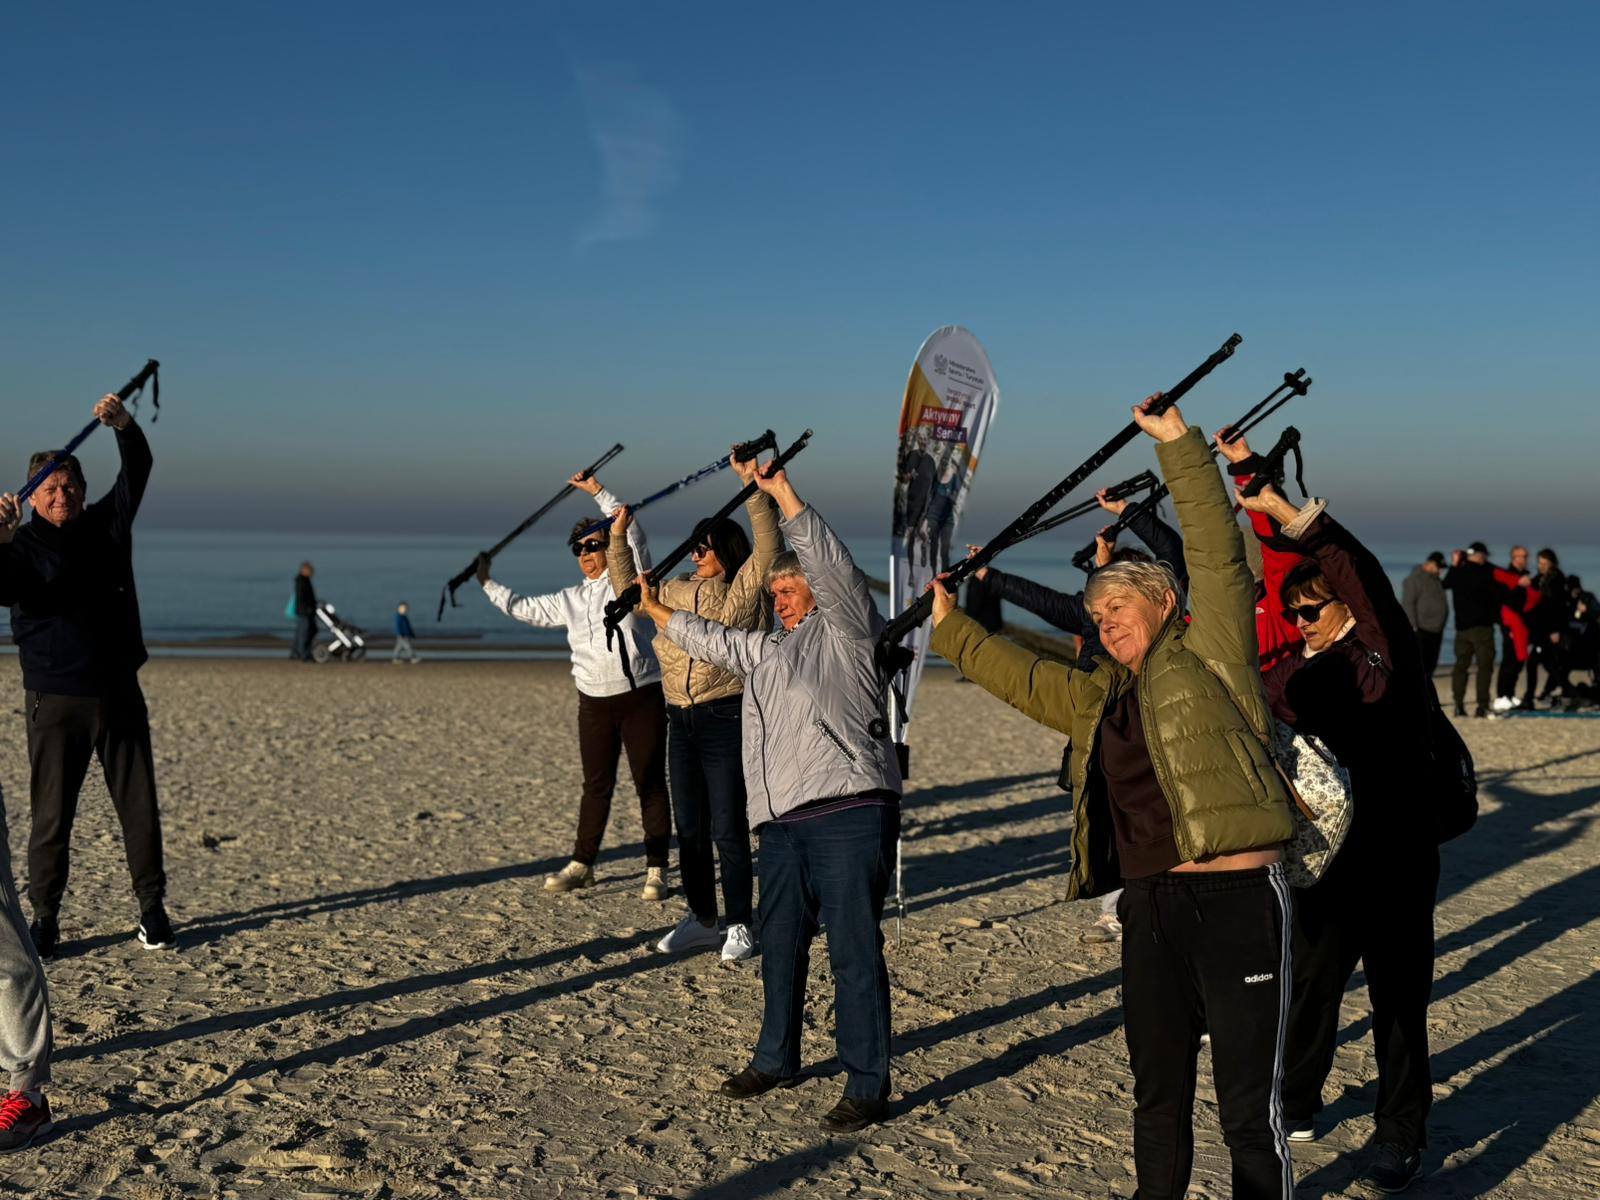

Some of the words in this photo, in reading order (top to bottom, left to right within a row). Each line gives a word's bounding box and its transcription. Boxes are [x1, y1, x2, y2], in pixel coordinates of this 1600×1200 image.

[921, 408, 961, 425] Aktywny
[936, 426, 963, 440] Senir
[1244, 973, 1274, 983] adidas
